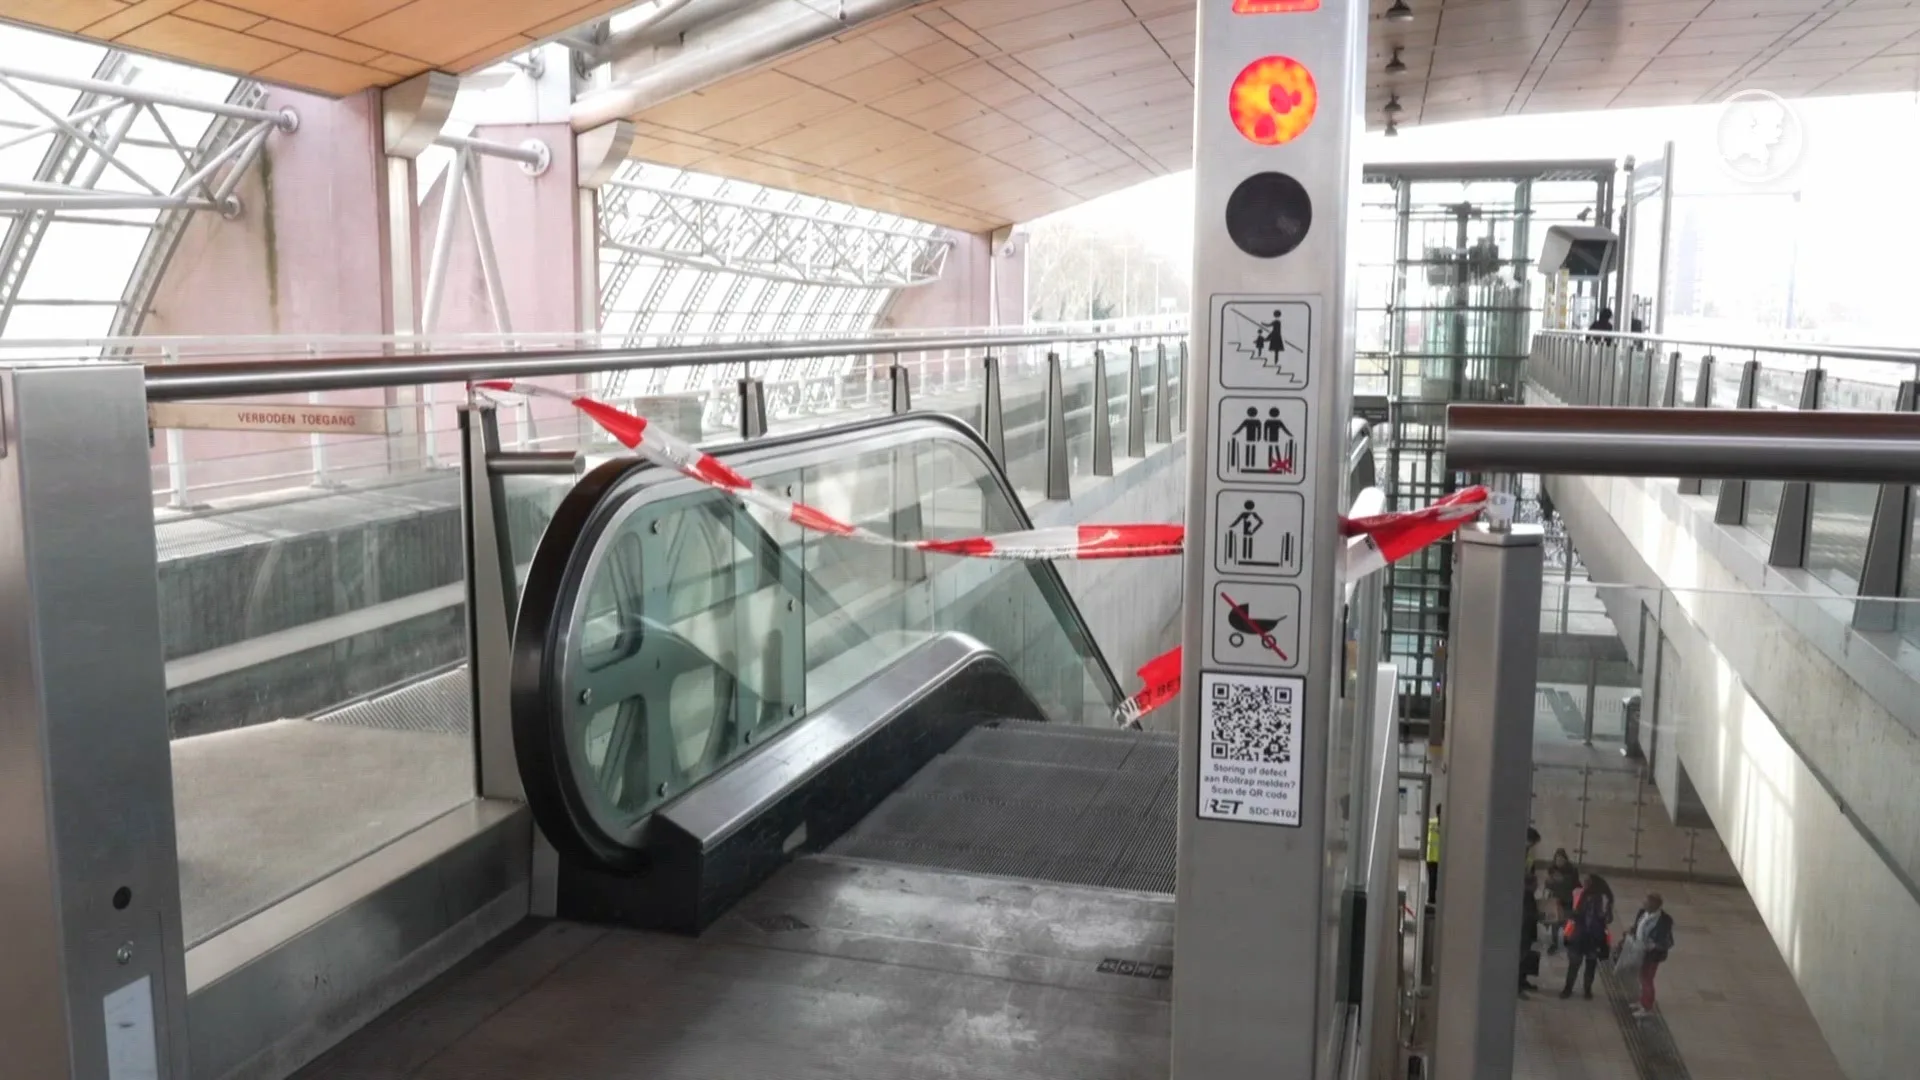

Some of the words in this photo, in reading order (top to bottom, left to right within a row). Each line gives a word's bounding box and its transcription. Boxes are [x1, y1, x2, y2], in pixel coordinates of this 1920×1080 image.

[238, 412, 296, 424] VERBODEN
[301, 414, 356, 426] TOEGANG
[1213, 763, 1246, 775] Storing
[1248, 765, 1257, 775] of
[1259, 766, 1287, 777] defect
[1222, 776, 1255, 786] Roltrap
[1257, 778, 1296, 789] melden?
[1211, 785, 1234, 795] Scan
[1236, 787, 1246, 796] de
[1249, 788, 1263, 798] QR
[1265, 790, 1288, 800] code
[1208, 798, 1244, 815] RET
[1249, 806, 1297, 818] SDC-RT02
